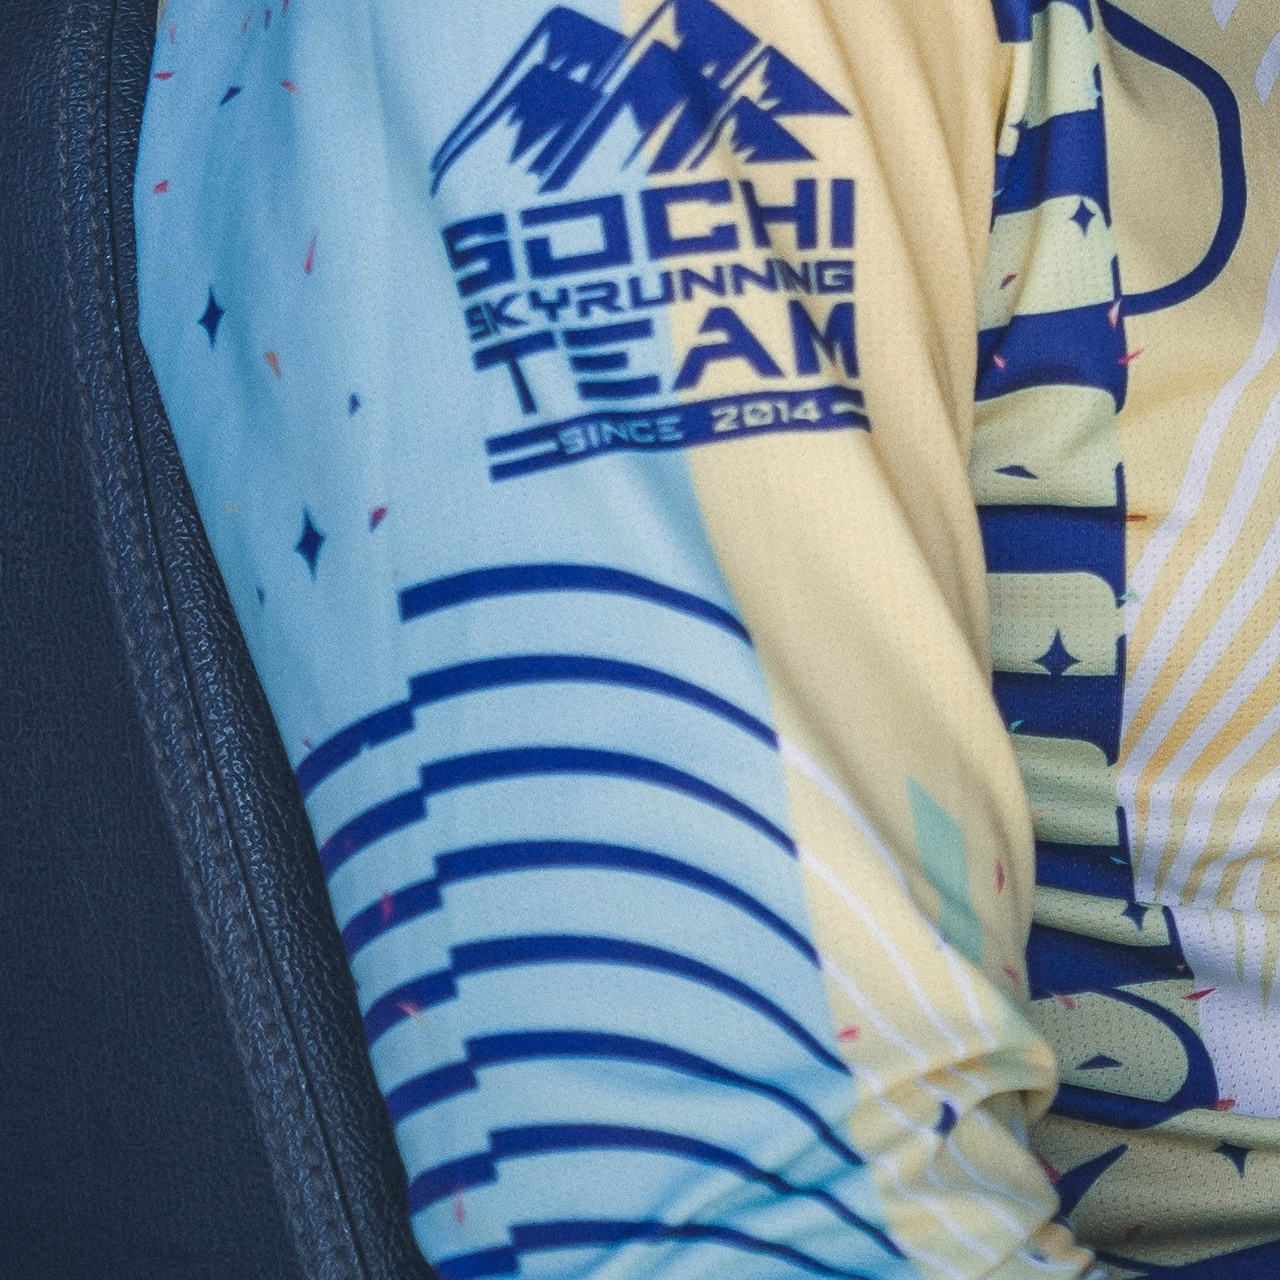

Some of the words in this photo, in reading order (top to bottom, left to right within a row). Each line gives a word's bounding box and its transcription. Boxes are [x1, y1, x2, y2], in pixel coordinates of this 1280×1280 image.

[442, 178, 856, 298] SOCHI
[473, 299, 860, 415] TEAM
[557, 414, 685, 455] SINCE
[711, 397, 822, 432] 2014
